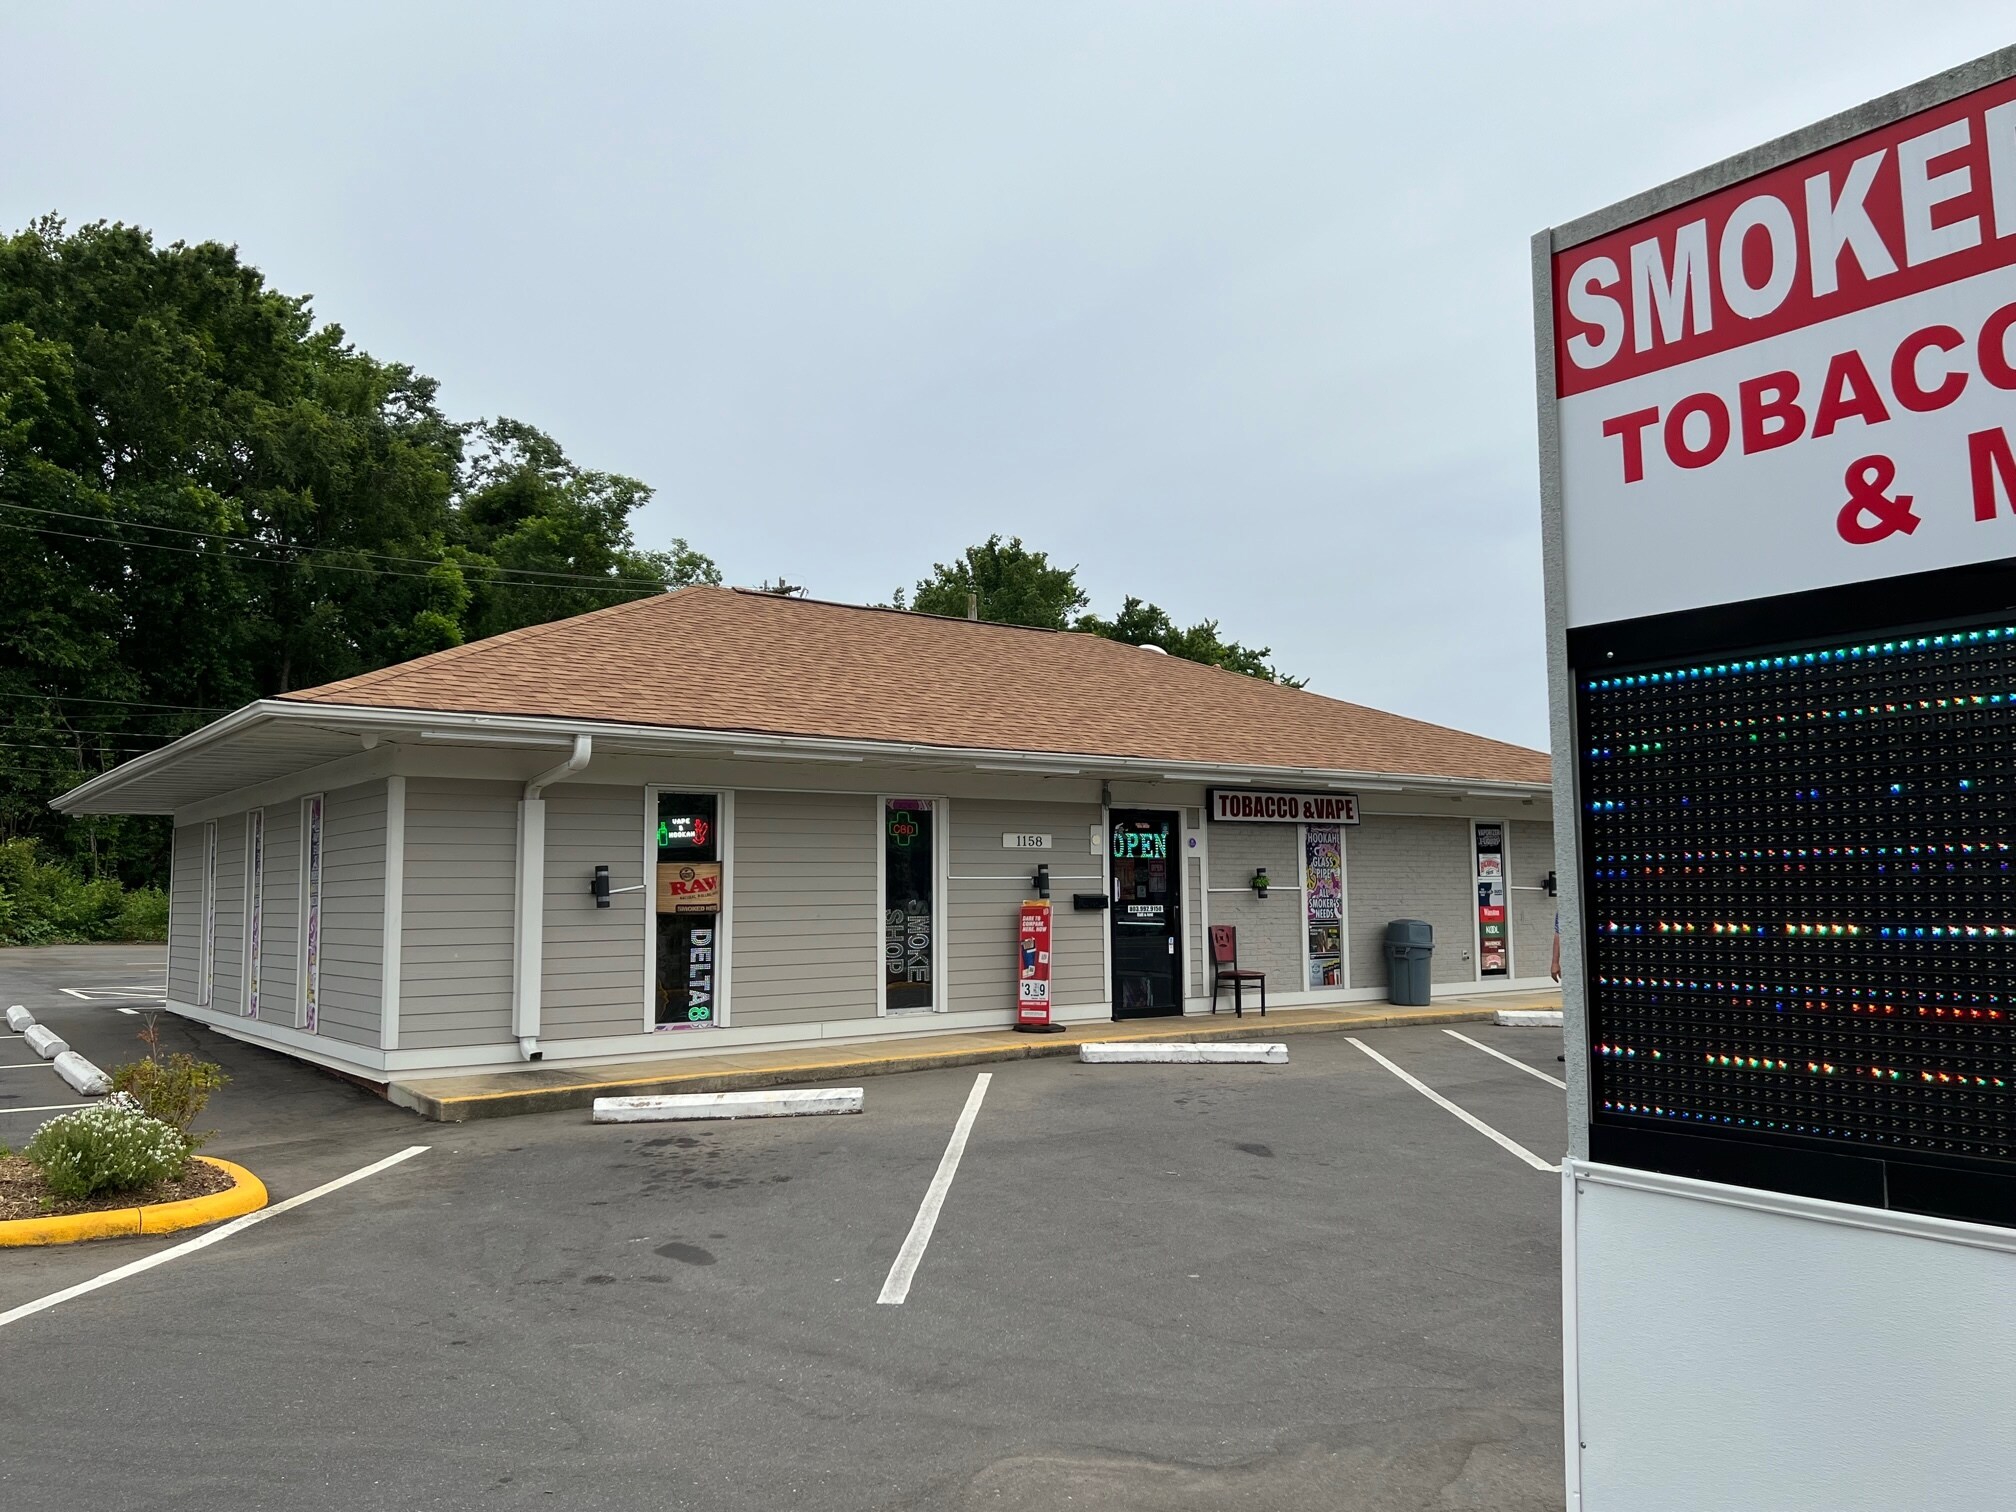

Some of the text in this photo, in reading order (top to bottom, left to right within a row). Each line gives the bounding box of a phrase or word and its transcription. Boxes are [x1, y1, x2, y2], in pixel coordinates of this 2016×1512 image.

[1836, 454, 1922, 545] &
[1218, 795, 1299, 818] TOBACCO
[893, 824, 914, 834] CBD
[1016, 836, 1043, 847] 1158
[1113, 833, 1167, 858] OPEN
[1312, 857, 1334, 867] GLASS
[669, 875, 718, 896] RAW
[1320, 888, 1329, 898] ALL
[1309, 899, 1340, 908] SMOKER'S
[1315, 909, 1334, 919] NEEDS
[886, 909, 904, 974] SHOP
[907, 899, 930, 983] SMOKE
